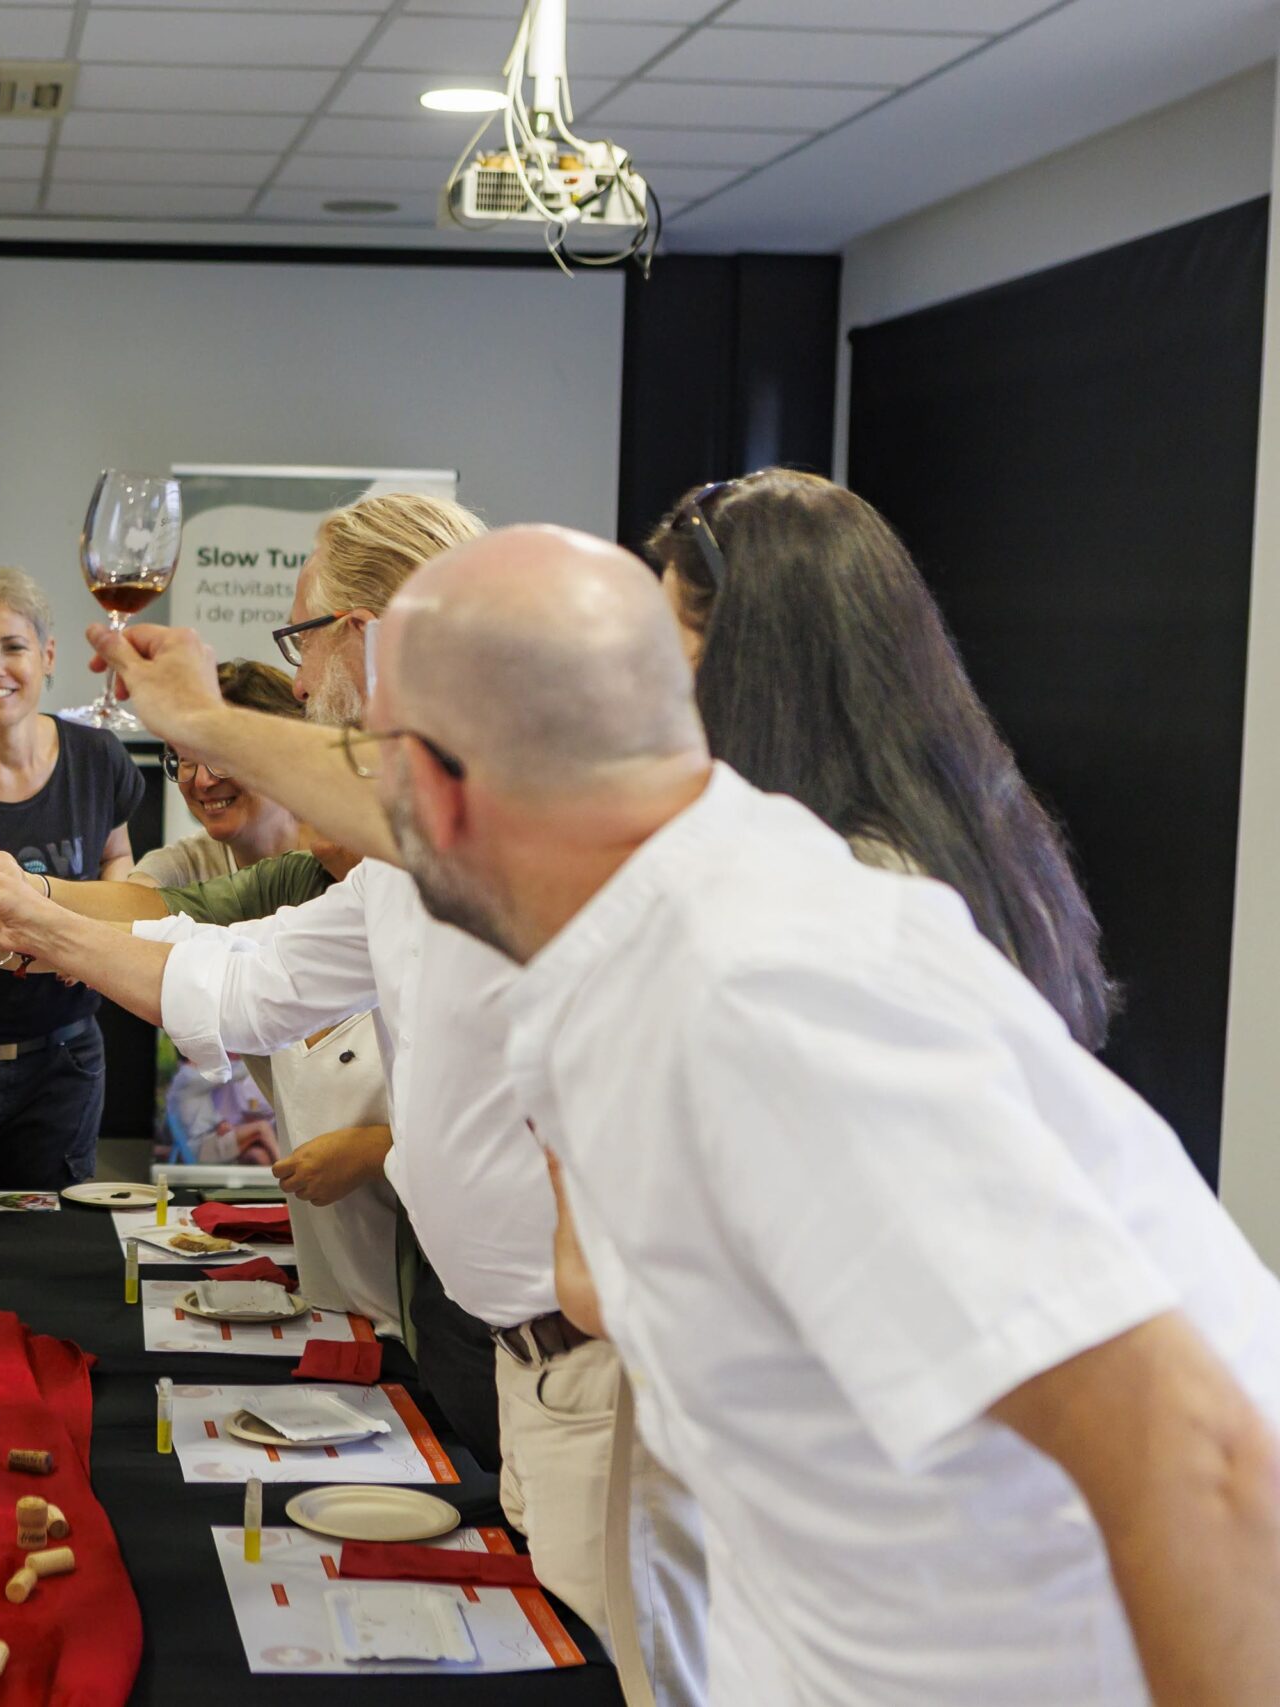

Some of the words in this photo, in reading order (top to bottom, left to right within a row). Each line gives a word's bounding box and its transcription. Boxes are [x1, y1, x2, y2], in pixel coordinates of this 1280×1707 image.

[197, 547, 259, 568] Slow
[197, 579, 294, 597] Activitats
[206, 605, 234, 623] de
